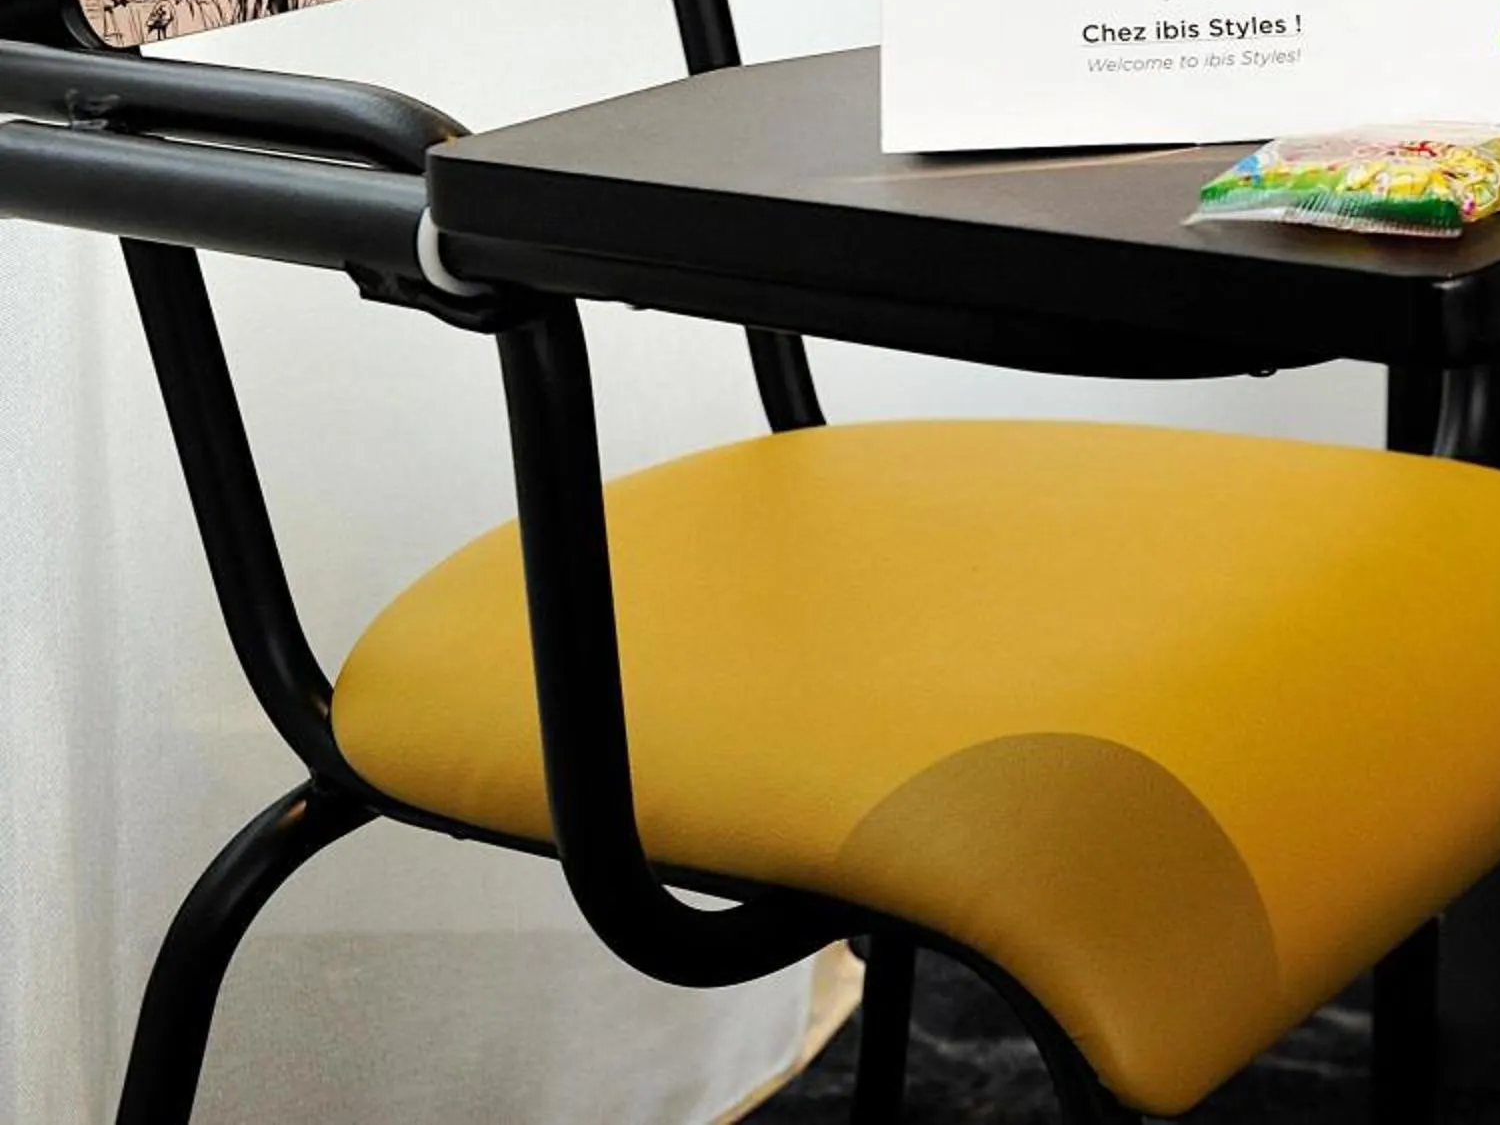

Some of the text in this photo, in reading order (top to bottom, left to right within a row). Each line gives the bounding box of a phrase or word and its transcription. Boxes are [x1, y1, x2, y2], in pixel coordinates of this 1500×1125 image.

[1082, 24, 1147, 43] Chez
[1155, 20, 1201, 40] ibis
[1208, 15, 1288, 39] Styles
[1087, 48, 1302, 73] Welcome to ibis Styles!
